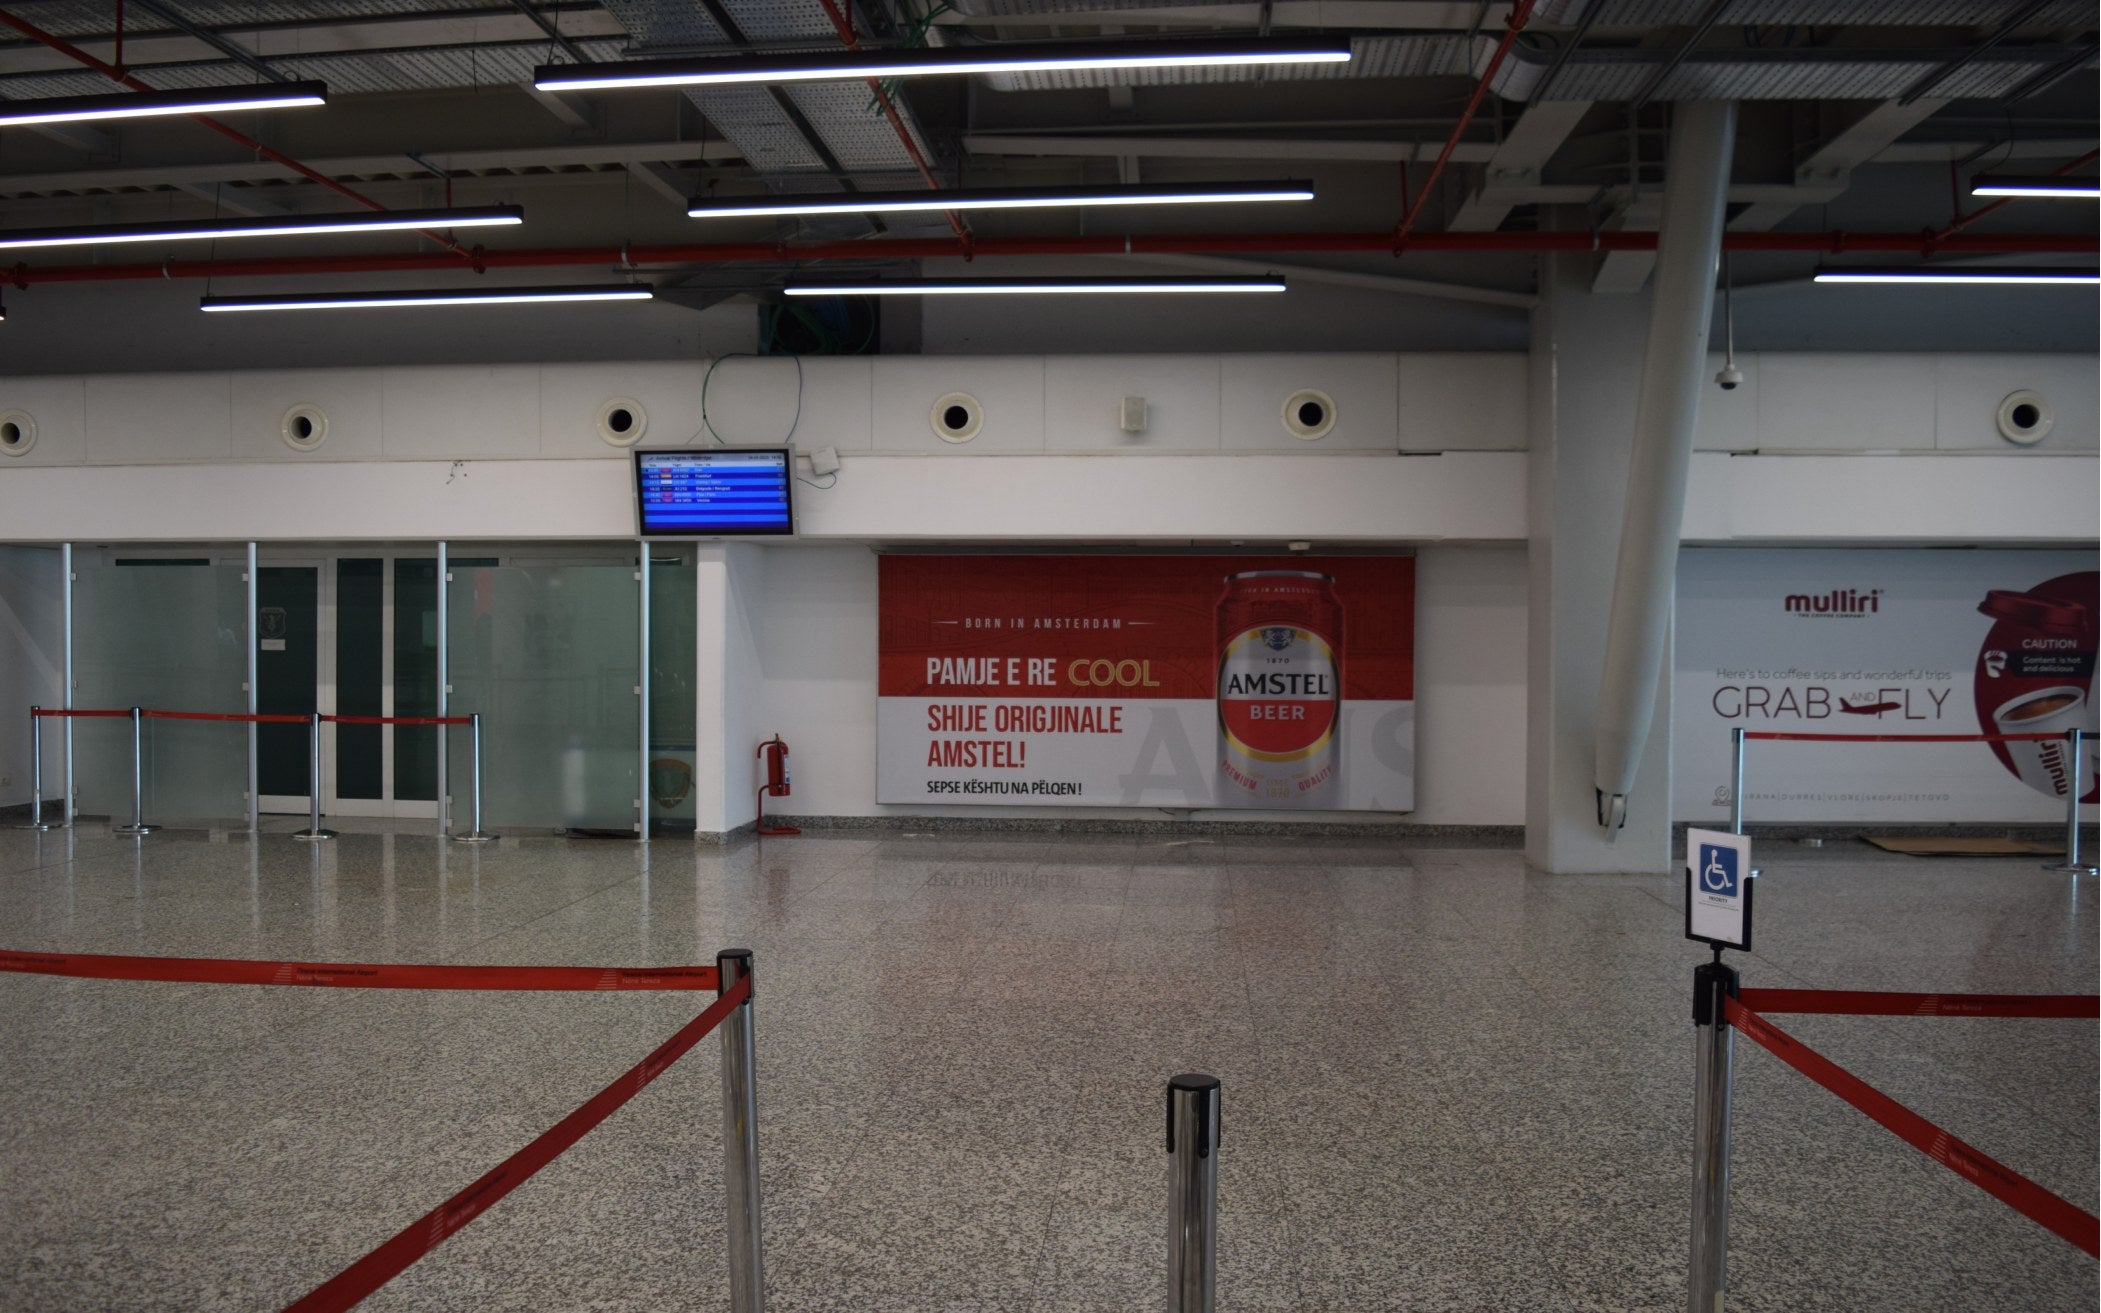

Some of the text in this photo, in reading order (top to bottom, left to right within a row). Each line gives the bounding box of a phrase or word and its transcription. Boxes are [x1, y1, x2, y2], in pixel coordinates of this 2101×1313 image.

[1784, 588, 1878, 613] mulliri
[965, 617, 1121, 630] BORN IN AMSTERDAM
[2022, 638, 2077, 649] CAUTION
[2022, 656, 2056, 664] Content
[2059, 656, 2066, 664] is
[926, 657, 1160, 687] PAMJE E RE COOL
[1716, 668, 1953, 682] Here's to coffee sips and wonderful trips
[1227, 673, 1329, 695] AMSTEL
[1712, 686, 1831, 719] GRAB
[1850, 692, 1875, 702] AND
[1878, 688, 1951, 720] FLY
[927, 704, 1123, 733] SHIJE ORIGJINALE
[1250, 704, 1305, 720] BEER
[927, 740, 1026, 768] AMSTEL!
[927, 780, 961, 794] SEPSE
[963, 778, 1009, 795] KËSHTU
[1011, 781, 1029, 795] NA
[1222, 760, 1258, 790] PREMIUM
[1298, 765, 1332, 791] QUALITY
